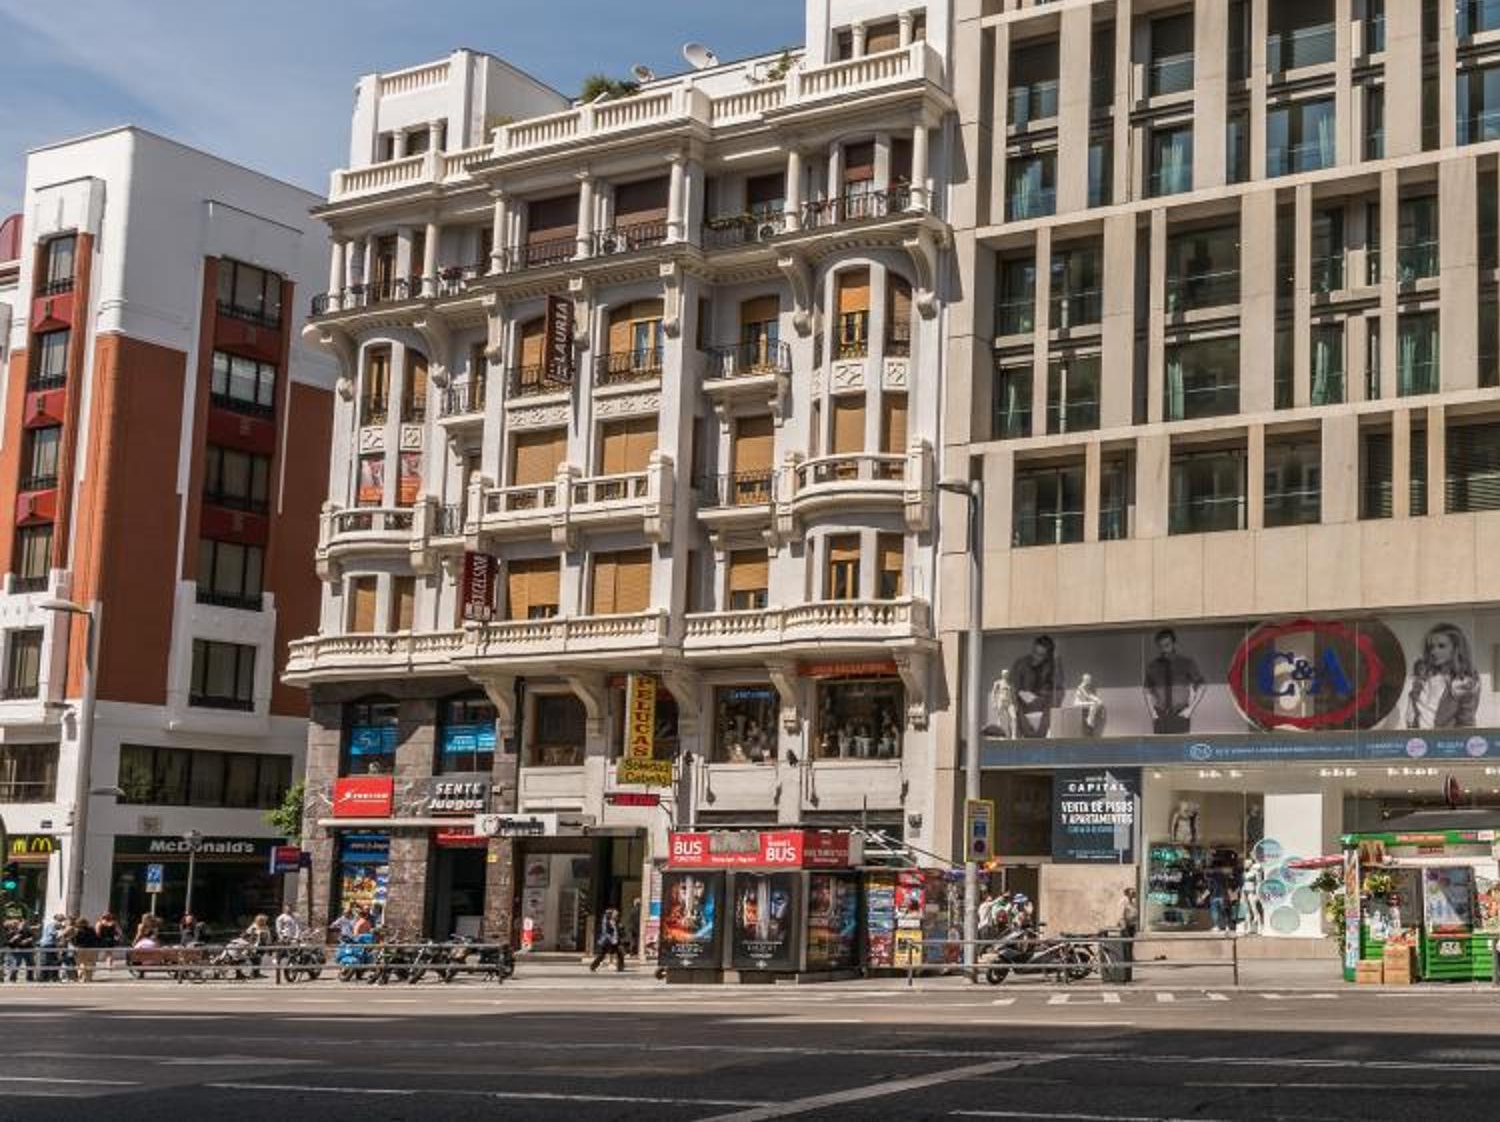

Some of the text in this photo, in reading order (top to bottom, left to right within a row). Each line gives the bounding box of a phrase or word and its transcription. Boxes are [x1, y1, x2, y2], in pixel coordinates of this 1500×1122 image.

[554, 303, 568, 363] LAURIA
[1257, 645, 1351, 696] C&A
[632, 677, 654, 758] PELUCAS
[435, 783, 482, 795] SENTE
[1068, 783, 1127, 793] CAPITAL
[429, 799, 483, 811] Juegos
[1061, 801, 1133, 813] VENTA DE PISOS
[1061, 813, 1133, 825] Y APARTAMENTOS
[149, 839, 255, 854] McDonald's
[673, 841, 702, 856] BUS
[765, 847, 797, 863] BUS
